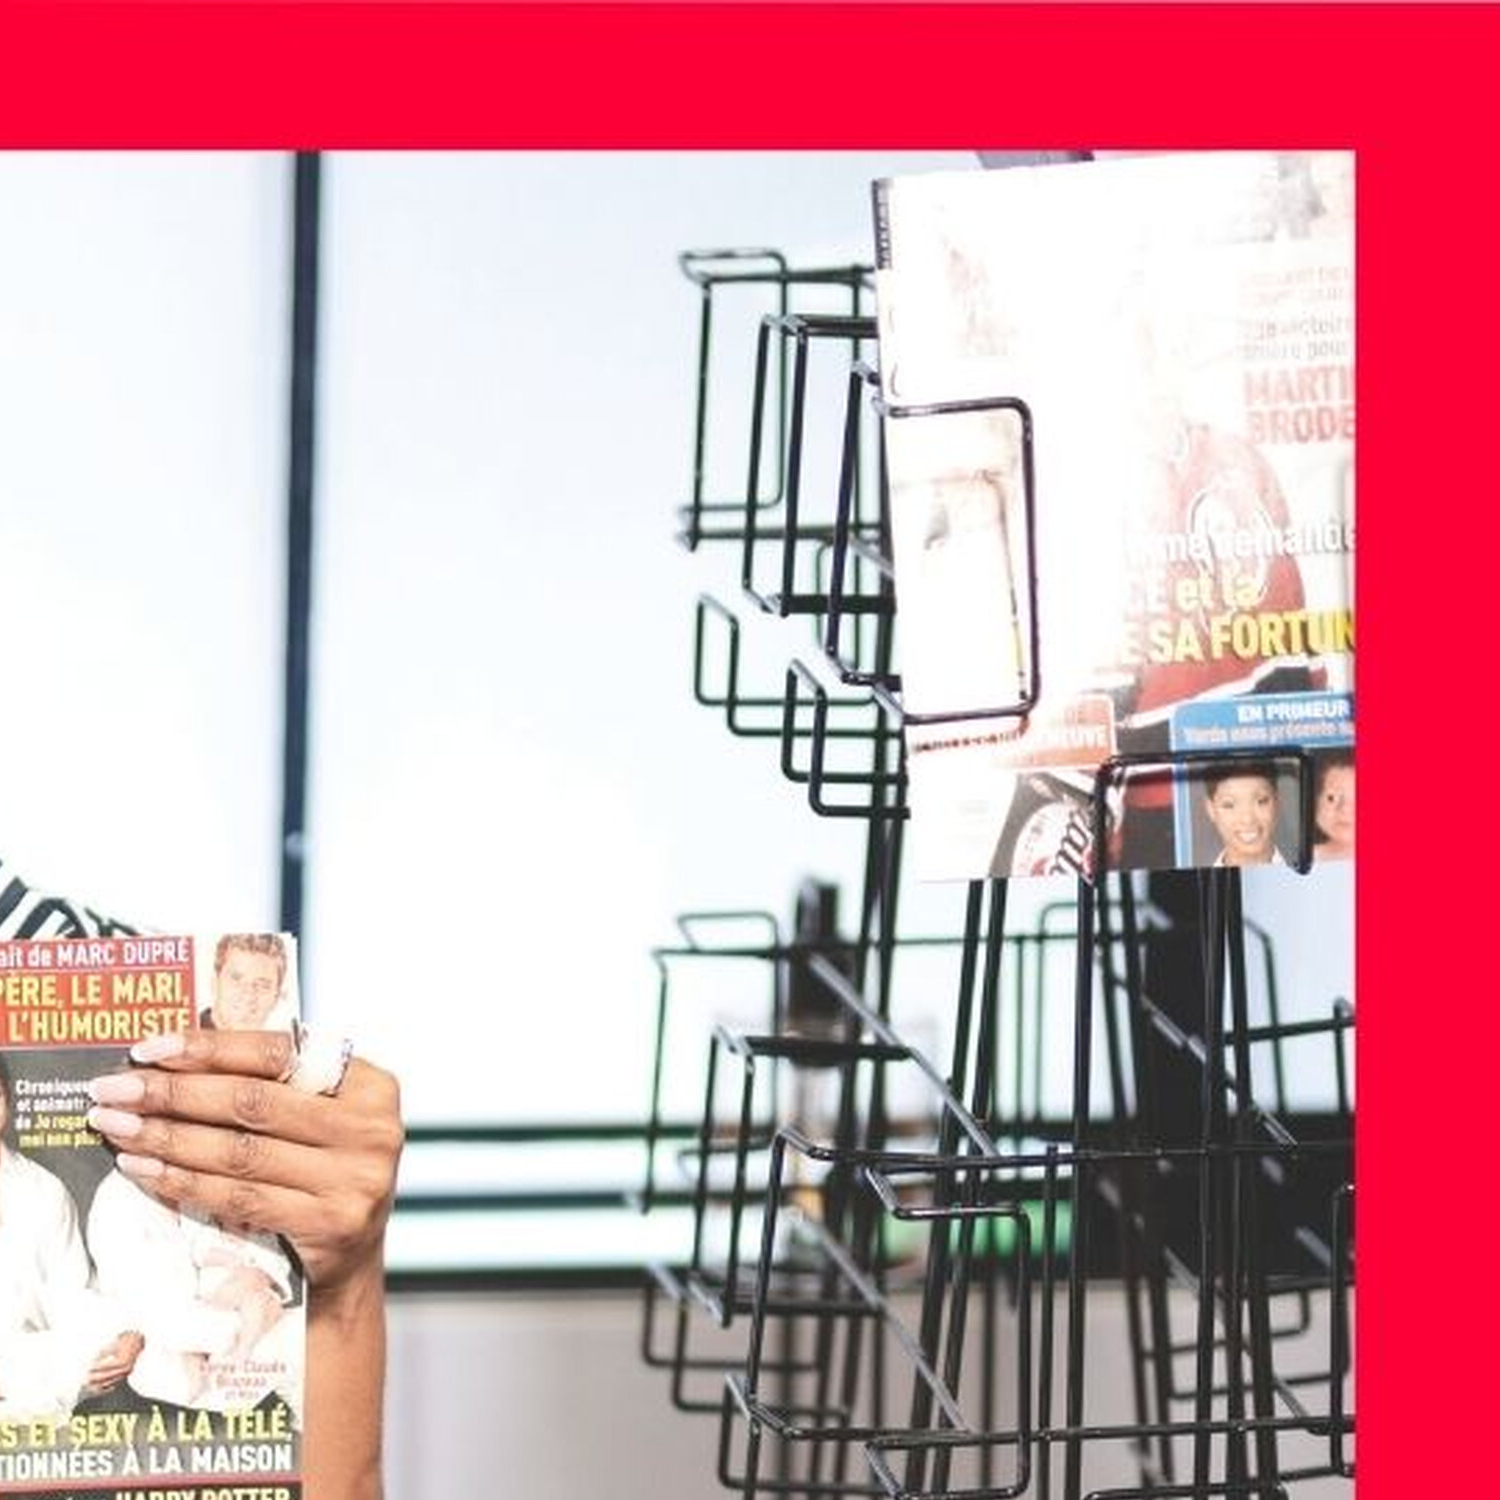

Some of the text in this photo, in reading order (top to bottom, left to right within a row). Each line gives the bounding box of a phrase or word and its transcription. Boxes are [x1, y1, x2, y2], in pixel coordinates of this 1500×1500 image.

[1243, 365, 1354, 406] MARTI
[1245, 404, 1355, 445] BRODE
[1149, 618, 1205, 663] SA
[1210, 608, 1354, 660] FORTUN
[1237, 704, 1263, 723] EN
[27, 947, 51, 968] de
[57, 945, 118, 967] MARC
[124, 937, 190, 965] DUPRÉ
[72, 976, 101, 1005] LE
[112, 972, 190, 1005] MARI,
[29, 1419, 56, 1446] ET
[71, 1413, 138, 1444] SEXY
[147, 1405, 166, 1441] À
[177, 1410, 213, 1441] LA
[123, 1439, 142, 1475] À
[149, 1445, 184, 1473] LA
[191, 1443, 293, 1472] MAISON
